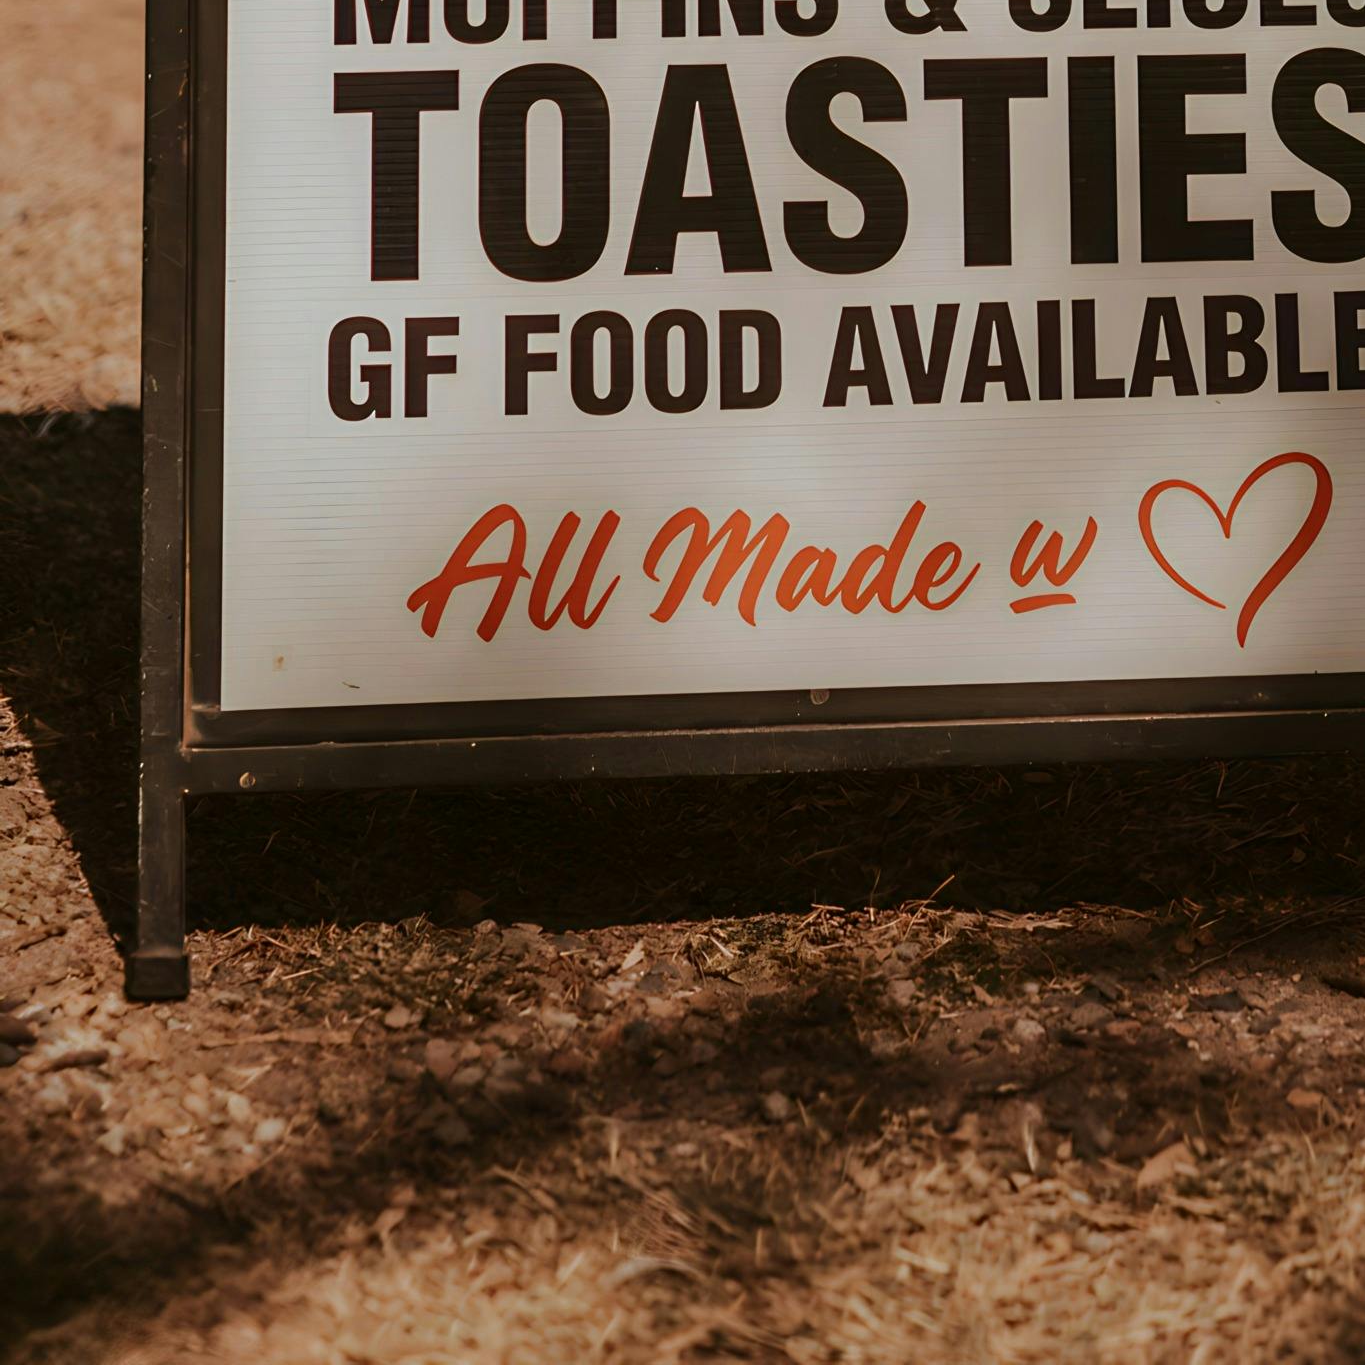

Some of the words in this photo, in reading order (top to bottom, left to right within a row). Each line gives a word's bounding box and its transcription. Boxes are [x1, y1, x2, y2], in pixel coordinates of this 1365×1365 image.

[328, 317, 459, 421] GF
[505, 309, 781, 415] FOOD
[407, 504, 620, 642] All
[643, 501, 980, 626] Made
